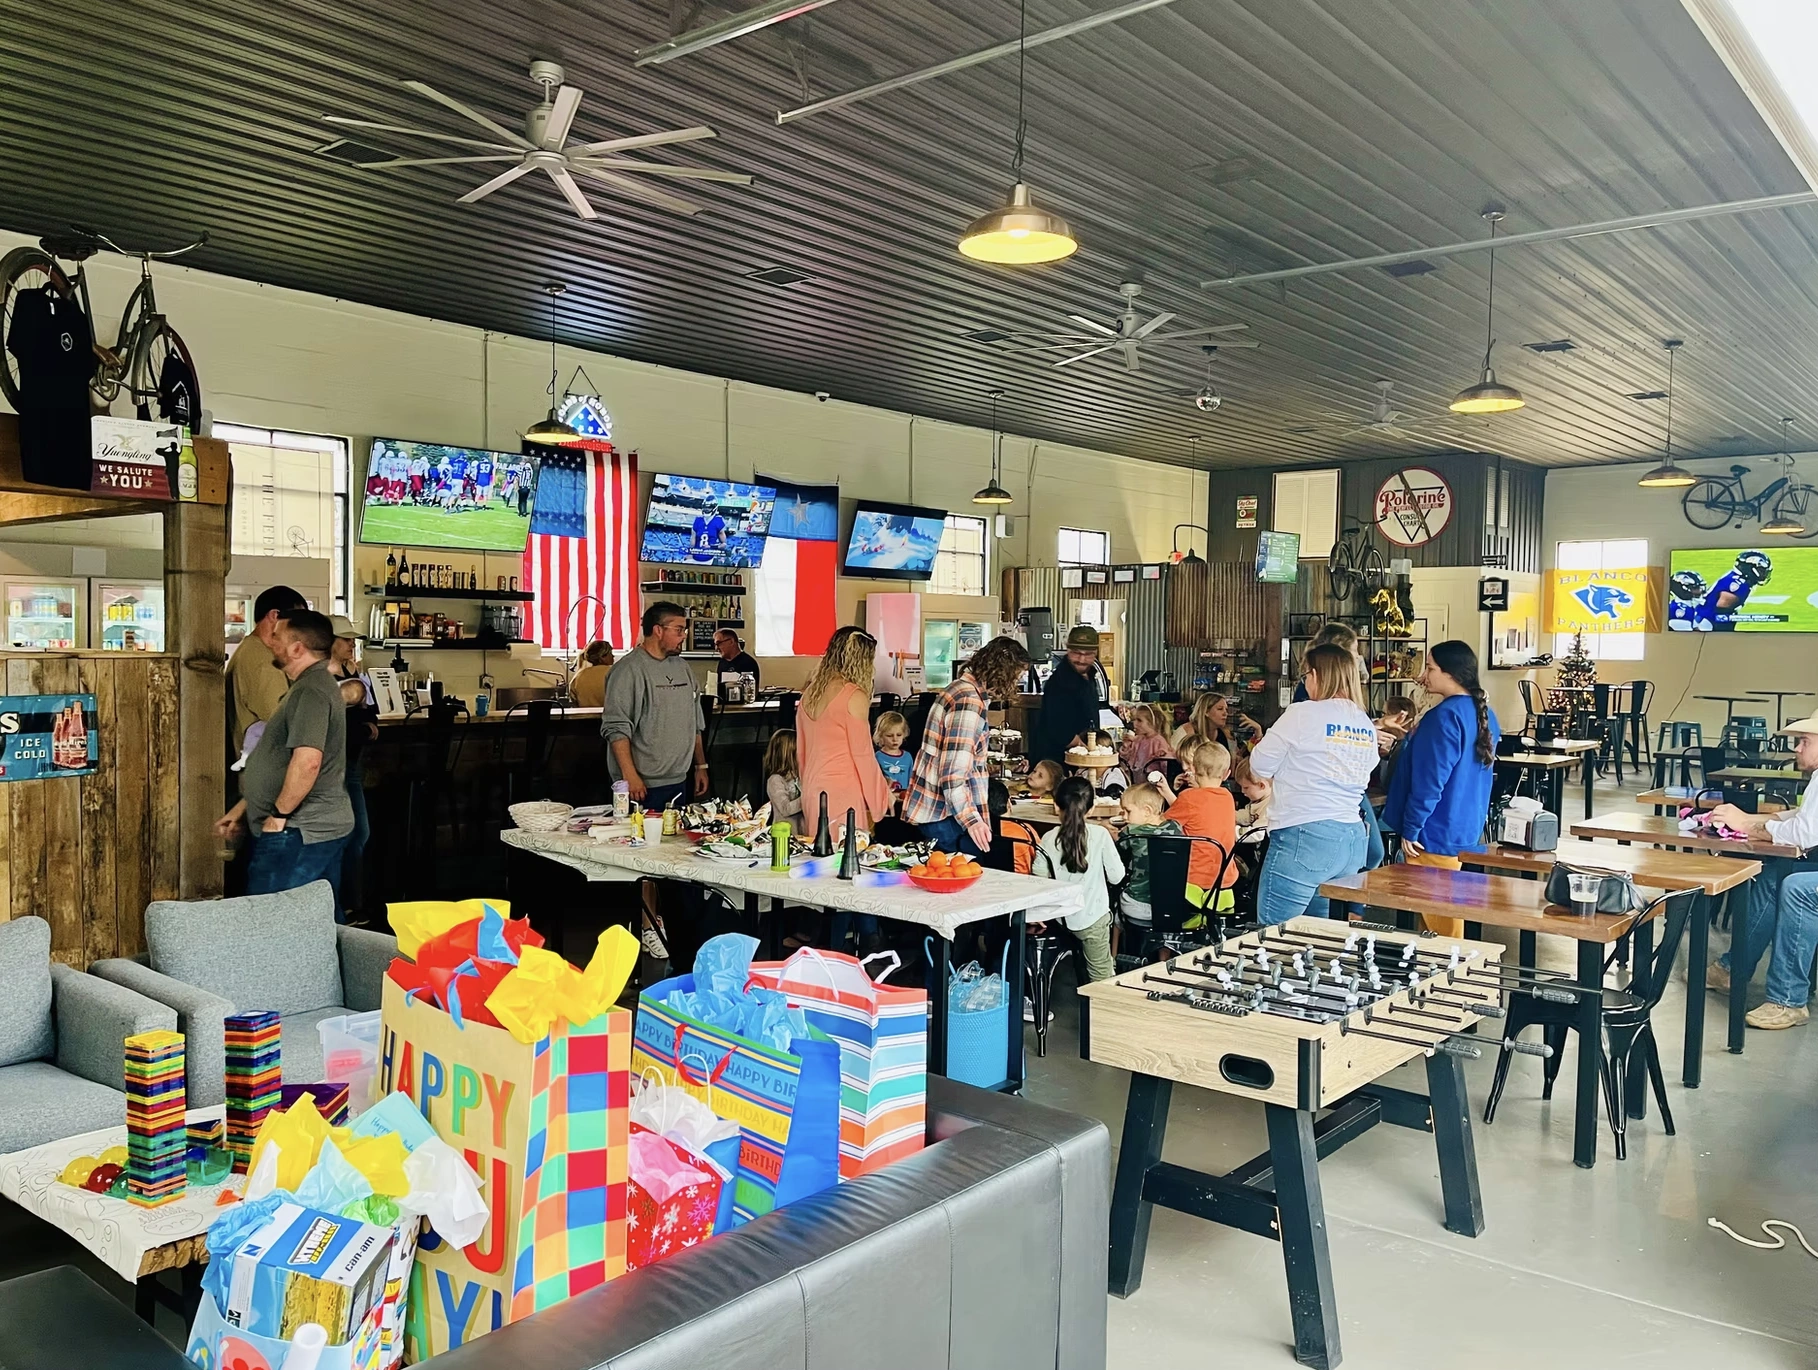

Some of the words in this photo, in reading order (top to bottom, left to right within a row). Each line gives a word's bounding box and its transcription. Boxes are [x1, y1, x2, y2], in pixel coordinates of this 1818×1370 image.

[97, 443, 152, 460] Yuengling
[99, 464, 112, 472] WE
[117, 466, 153, 476] SALUTE
[110, 474, 143, 489] YOU
[262, 472, 274, 506] THE
[1400, 513, 1420, 521] CONSU
[262, 514, 275, 557] FEED
[1560, 571, 1648, 585] BLANCO
[1558, 616, 1646, 631] PANTHERS
[1326, 724, 1374, 743] BLANCO
[20, 738, 41, 748] ICE
[14, 749, 46, 760] COLD
[726, 1062, 771, 1089] HAPPY
[379, 1023, 517, 1150] HAPPY
[345, 1236, 376, 1272] can-am
